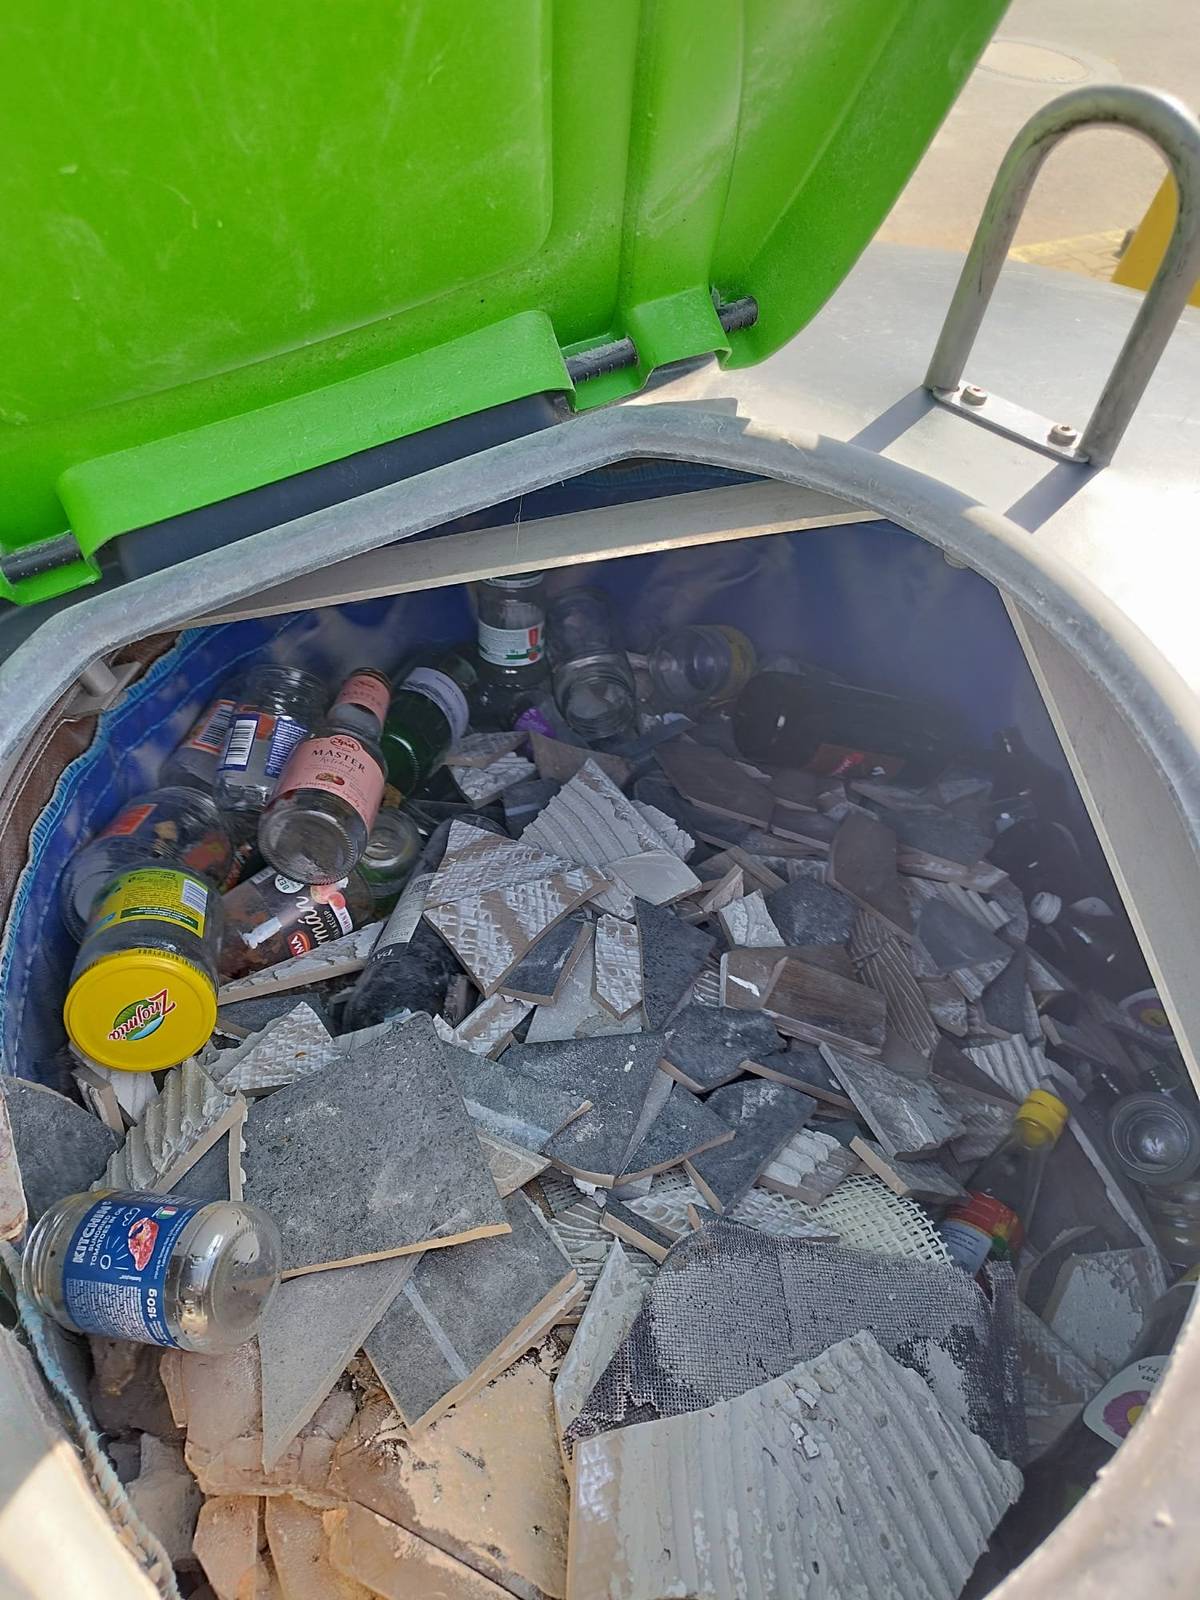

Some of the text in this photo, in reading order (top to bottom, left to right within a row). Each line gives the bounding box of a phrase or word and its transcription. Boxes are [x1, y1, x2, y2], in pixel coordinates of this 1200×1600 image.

[312, 750, 367, 774] MASTER
[88, 1215, 111, 1252] SUNDRIED
[90, 1225, 111, 1266] TOMATOES
